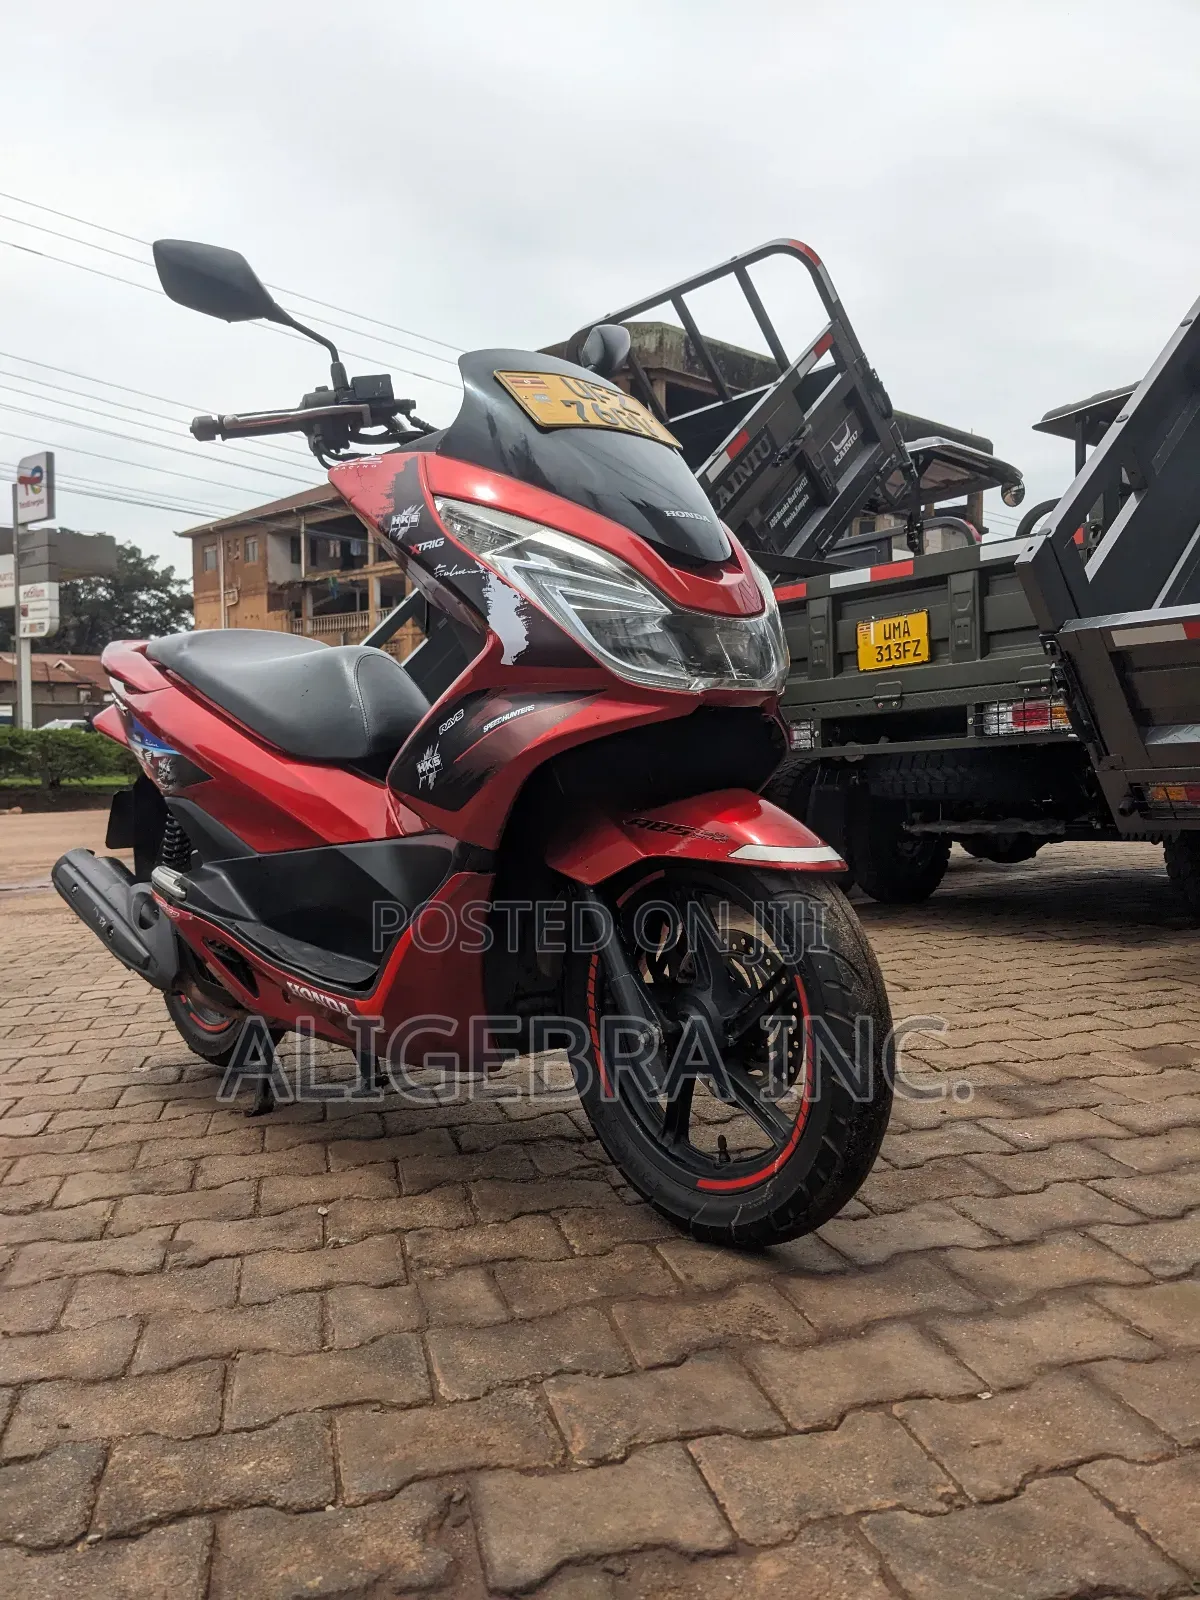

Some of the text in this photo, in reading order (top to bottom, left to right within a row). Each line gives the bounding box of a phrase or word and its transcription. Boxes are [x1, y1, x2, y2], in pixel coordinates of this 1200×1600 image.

[559, 377, 641, 416] UFZ
[833, 430, 858, 466] KAINIU
[711, 433, 771, 514] AINIU
[391, 514, 420, 527] HKS
[663, 510, 712, 524] HONDA
[408, 537, 445, 554] XTRIG
[883, 619, 911, 641] UMA
[875, 639, 922, 663] 313FZ
[439, 708, 465, 735] RAYS
[416, 753, 443, 775] HKS
[286, 981, 358, 1019] HONDA
